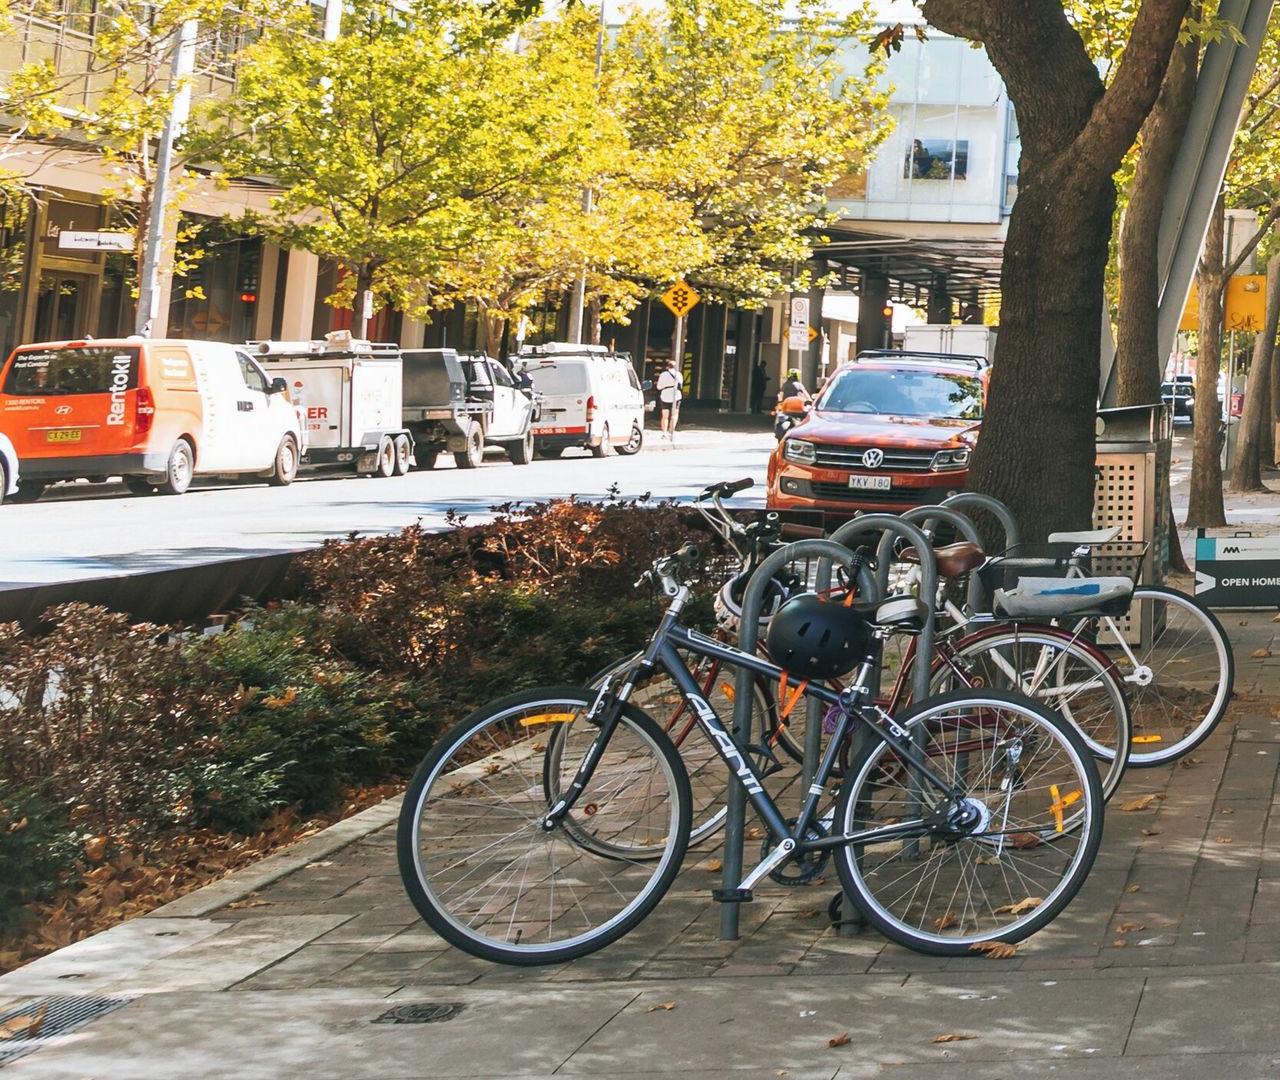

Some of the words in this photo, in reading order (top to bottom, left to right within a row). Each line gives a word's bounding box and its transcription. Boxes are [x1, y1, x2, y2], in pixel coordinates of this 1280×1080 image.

[106, 354, 132, 425] Rentokil
[851, 476, 867, 487] YKV
[1221, 578, 1250, 587] OPEN
[686, 692, 764, 795] AVANTI
